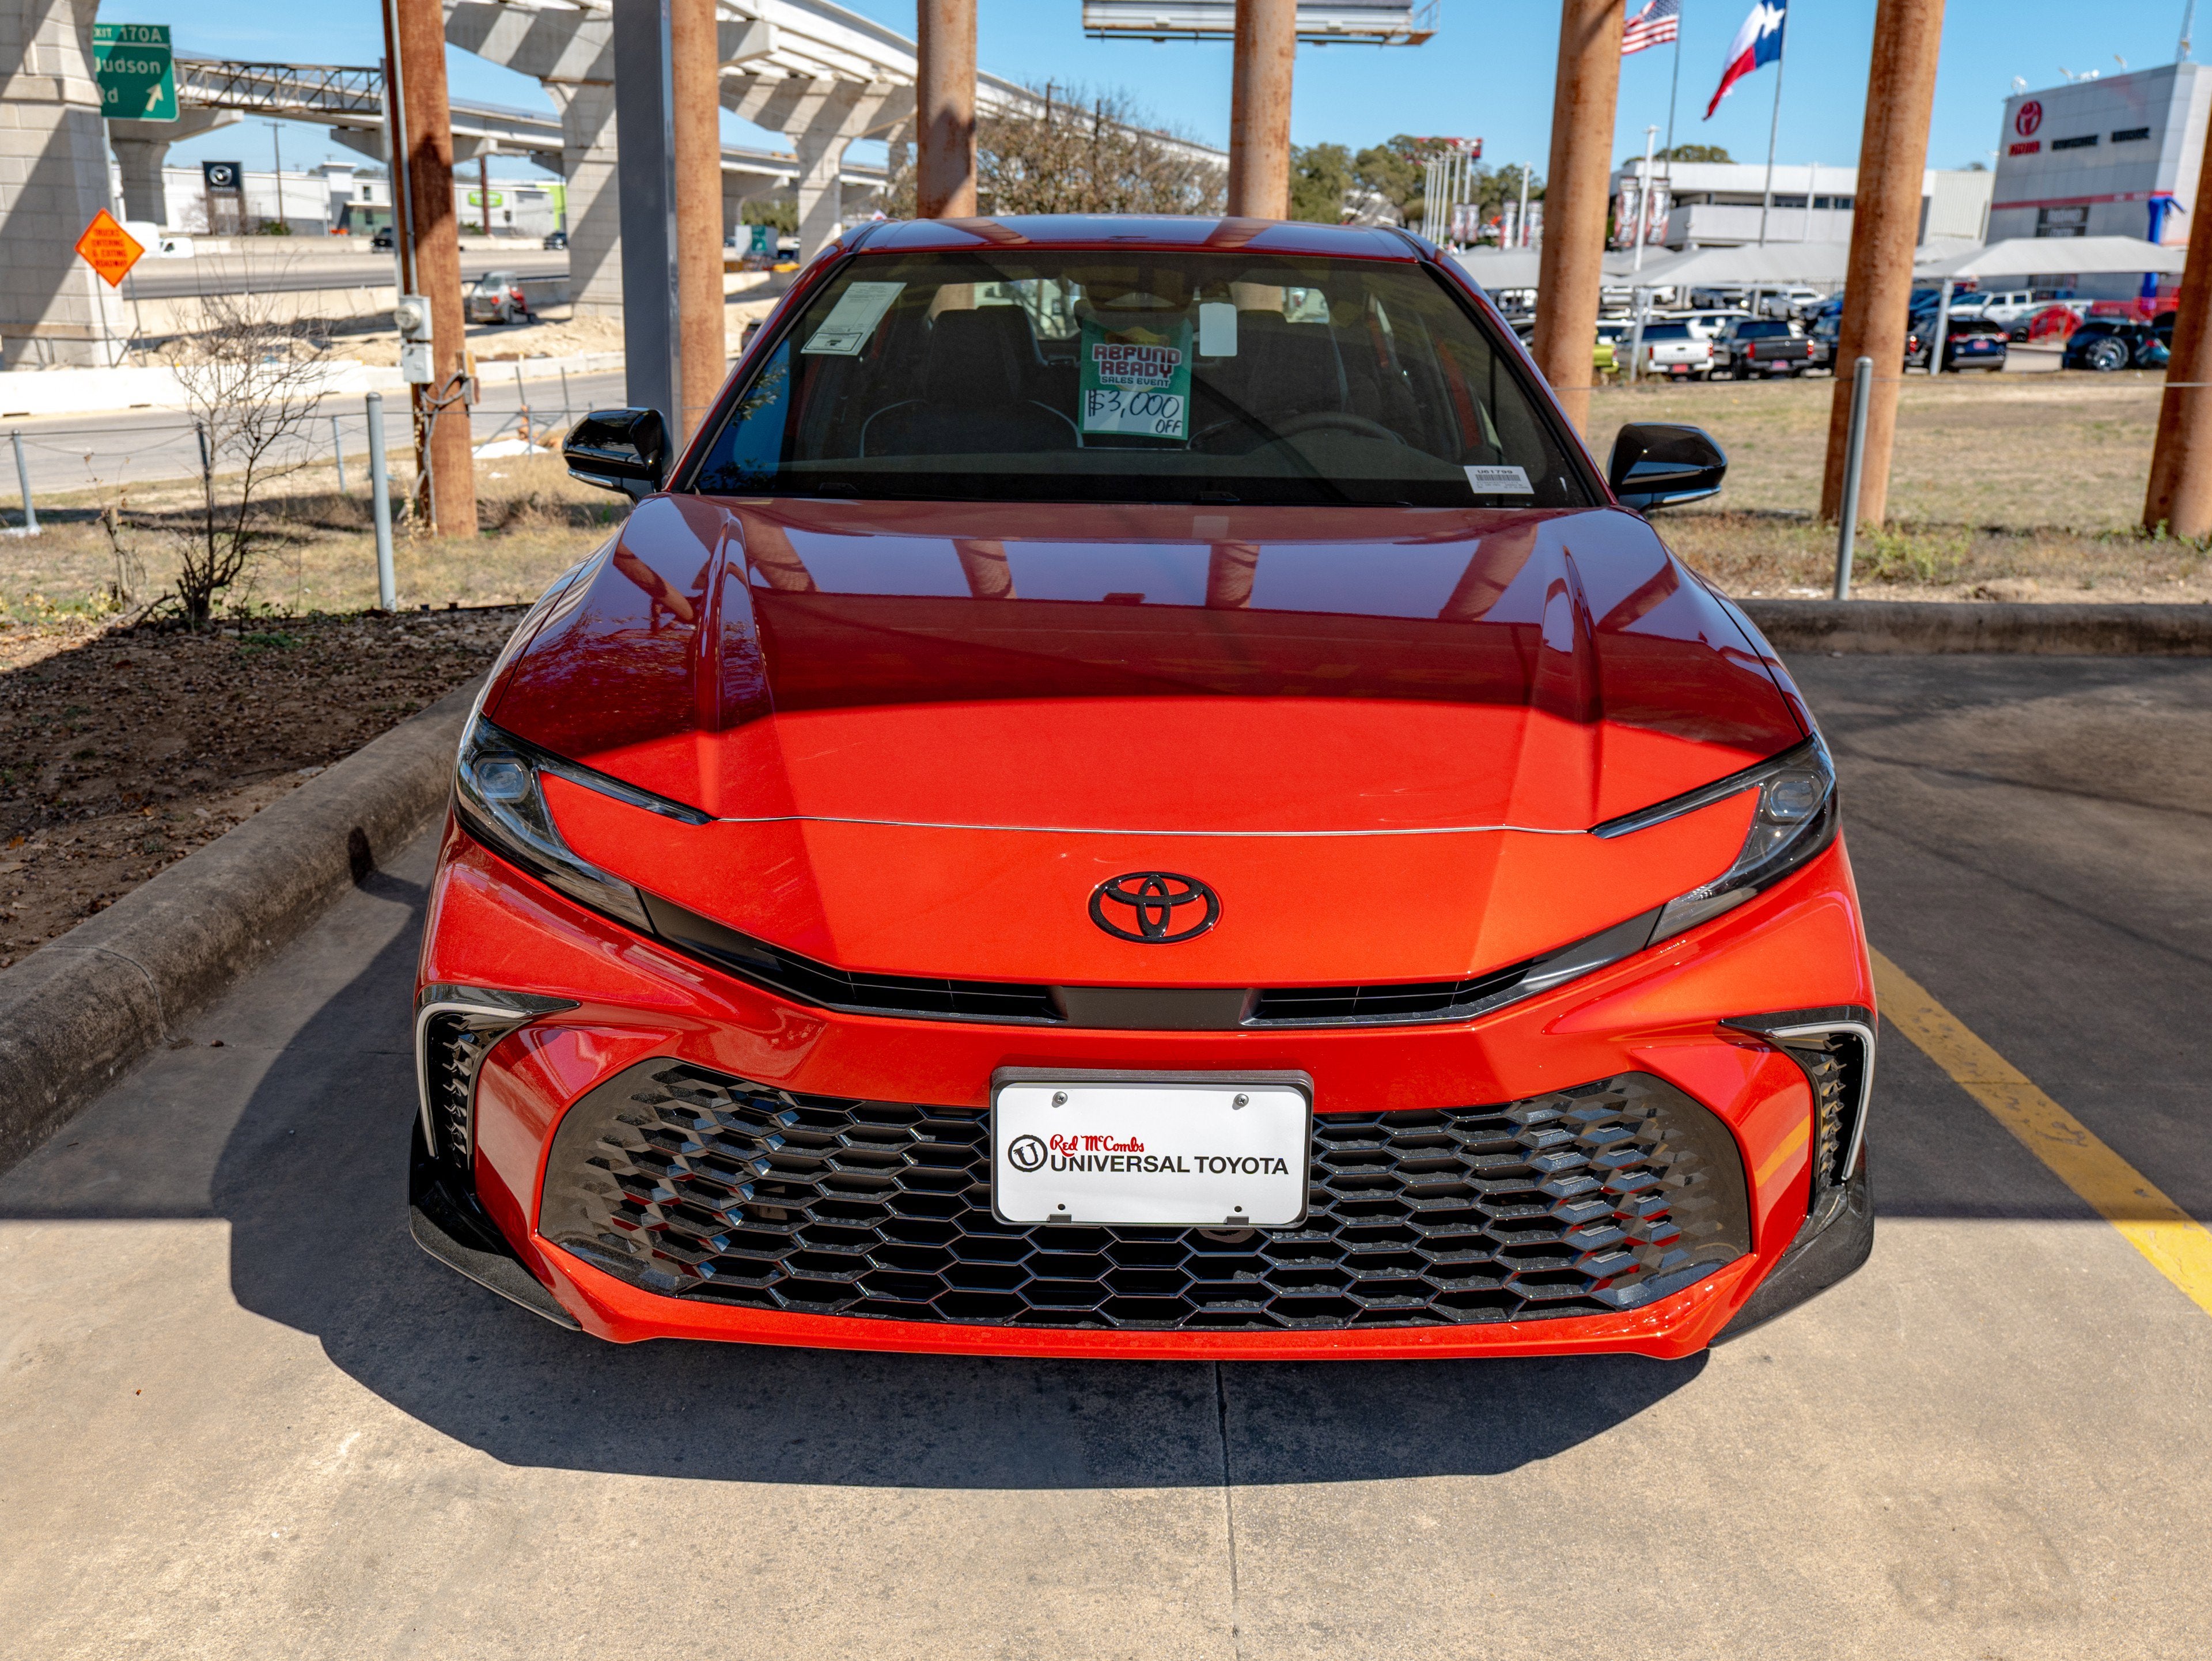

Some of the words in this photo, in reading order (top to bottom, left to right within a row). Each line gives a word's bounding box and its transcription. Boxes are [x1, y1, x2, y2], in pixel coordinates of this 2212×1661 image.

[93, 27, 112, 38] XIT
[121, 27, 162, 42] 170A
[1093, 344, 1181, 365] REFUND
[1101, 361, 1172, 379] READY
[1101, 376, 1134, 384] SALES
[1137, 377, 1169, 387] EVENT
[1088, 389, 1179, 418] $3,000
[1155, 419, 1183, 433] OFF
[1050, 1134, 1078, 1157] Red
[1080, 1135, 1144, 1152] McCombs
[1051, 1155, 1190, 1173] UNIVERSAL
[1194, 1156, 1289, 1175] TOYOTA
